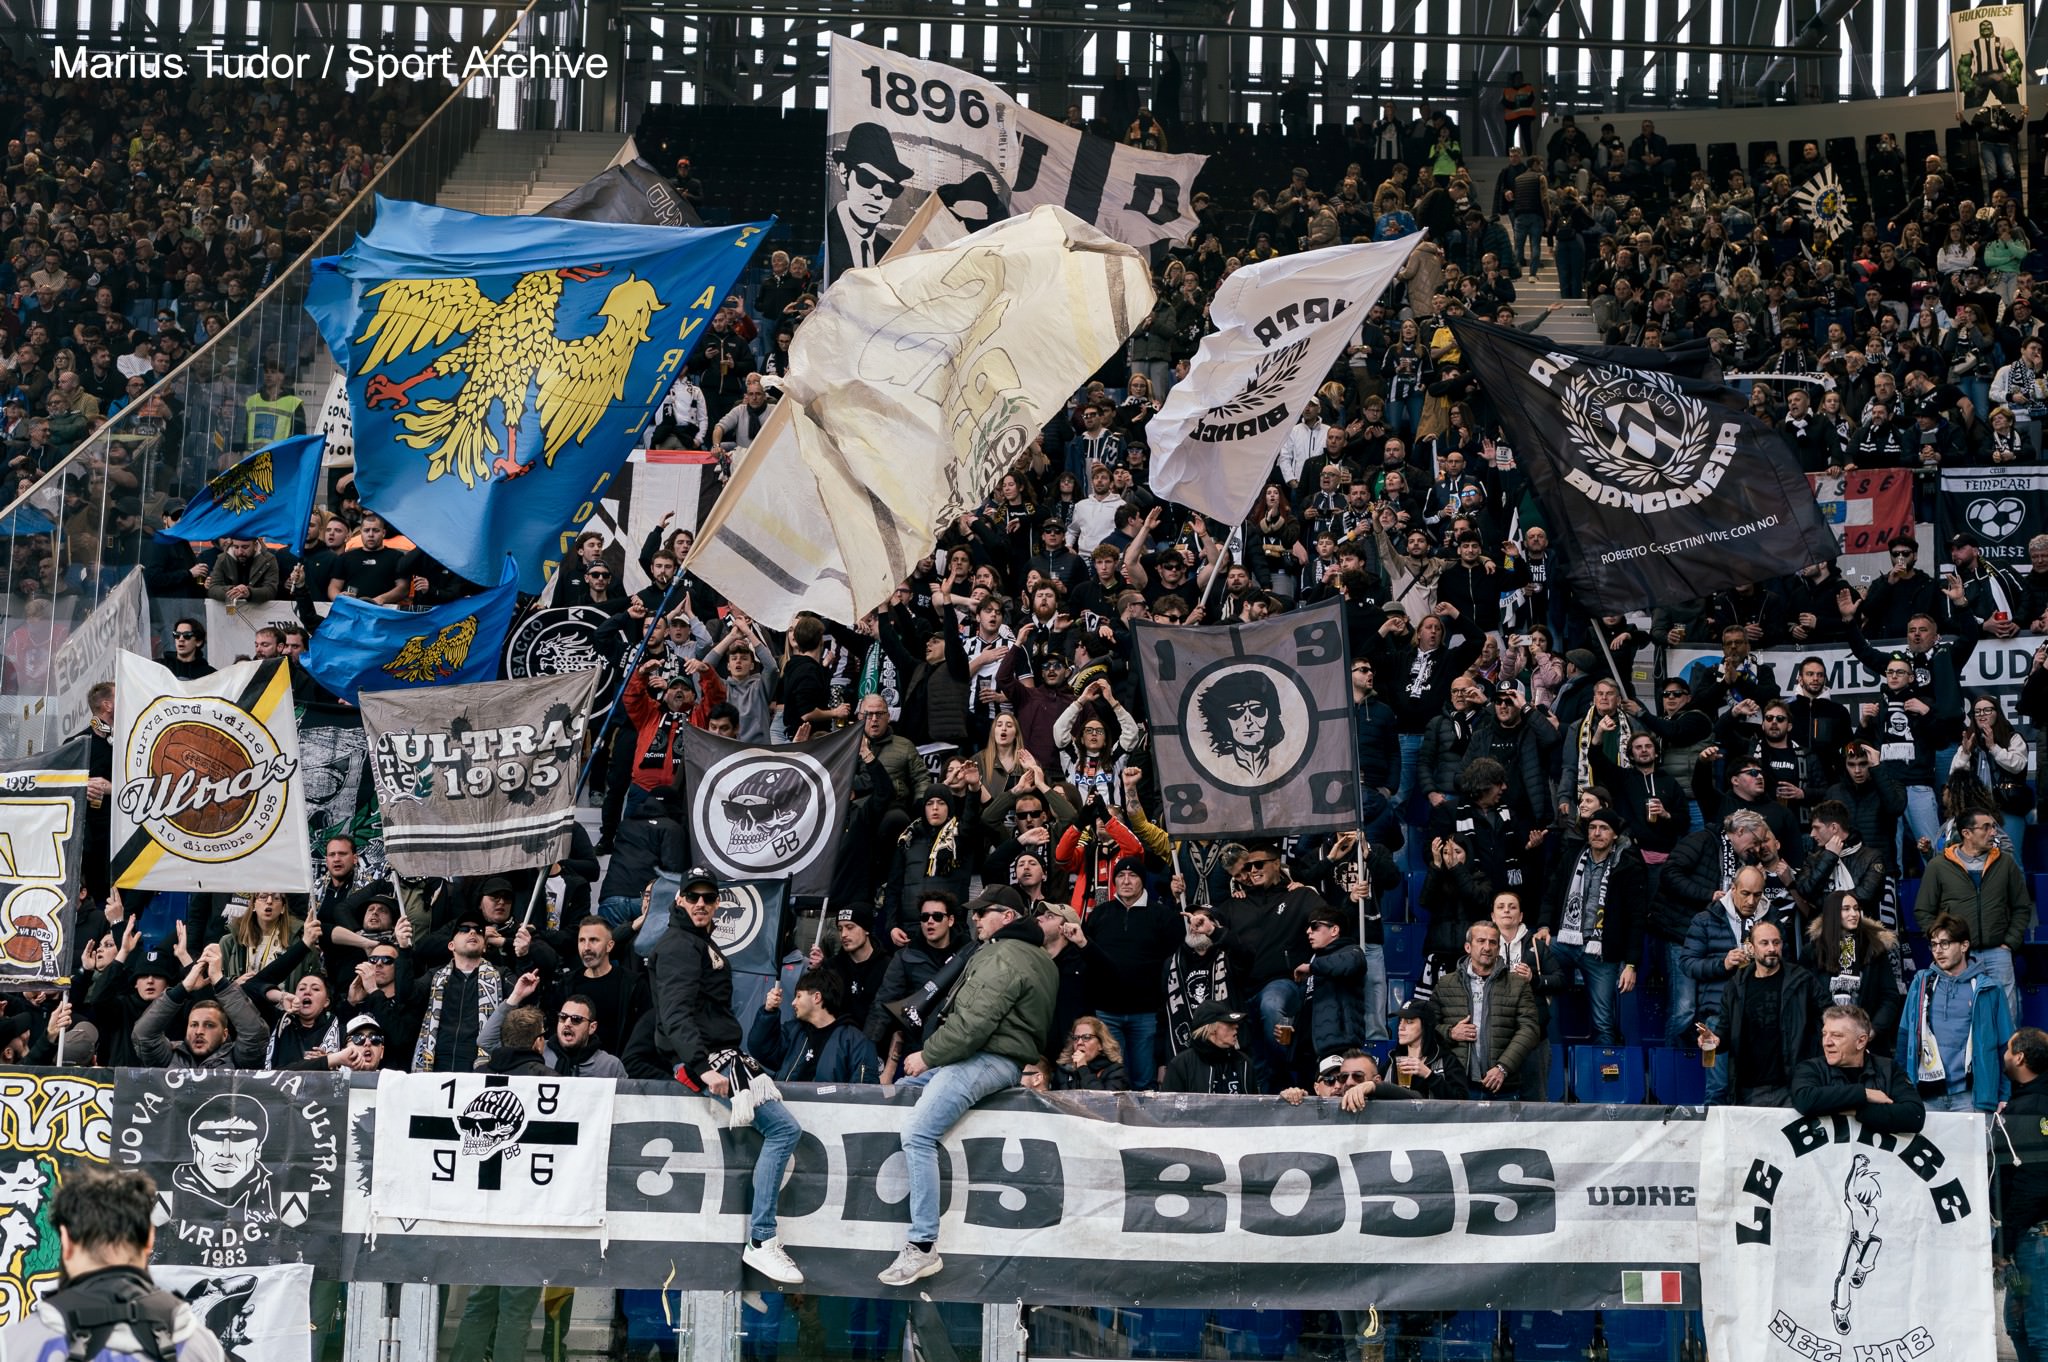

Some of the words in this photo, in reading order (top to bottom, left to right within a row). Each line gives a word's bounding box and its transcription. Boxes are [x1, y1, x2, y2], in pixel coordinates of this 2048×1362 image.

[1958, 6, 2014, 23] HULKDINESE
[862, 65, 989, 128] 1896
[1626, 382, 1677, 417] CALCIO
[1563, 423, 1741, 514] BIANCONERA
[1964, 477, 2031, 492] TEMPLARI
[1601, 544, 1647, 565] ROBERTO
[1649, 534, 1706, 556] CSSETTINI
[1705, 529, 1730, 544] VIVE
[1730, 522, 1756, 539] CON
[1757, 515, 1780, 532] NOI
[512, 619, 544, 677] SACCO
[1294, 620, 1344, 666] 9
[135, 714, 162, 768] curva
[163, 704, 202, 718] nord
[212, 709, 264, 754] udine
[391, 707, 587, 763] ULTRAS
[5, 775, 36, 790] 1995
[118, 753, 298, 825] Ultras
[443, 756, 561, 799] 1995
[183, 832, 254, 852] dicembre
[254, 794, 278, 830] 1995
[1164, 783, 1208, 825] 8
[772, 833, 800, 858] BB
[440, 1078, 457, 1109] 1
[502, 1142, 522, 1160] BB
[1119, 1147, 1557, 1238] BOYS
[1587, 1185, 1697, 1207] UDINE
[1735, 1158, 1784, 1246] LE
[178, 1219, 270, 1247] V.R.D.G.
[200, 1248, 248, 1266] 1983
[1768, 1309, 1842, 1362] SEZ
